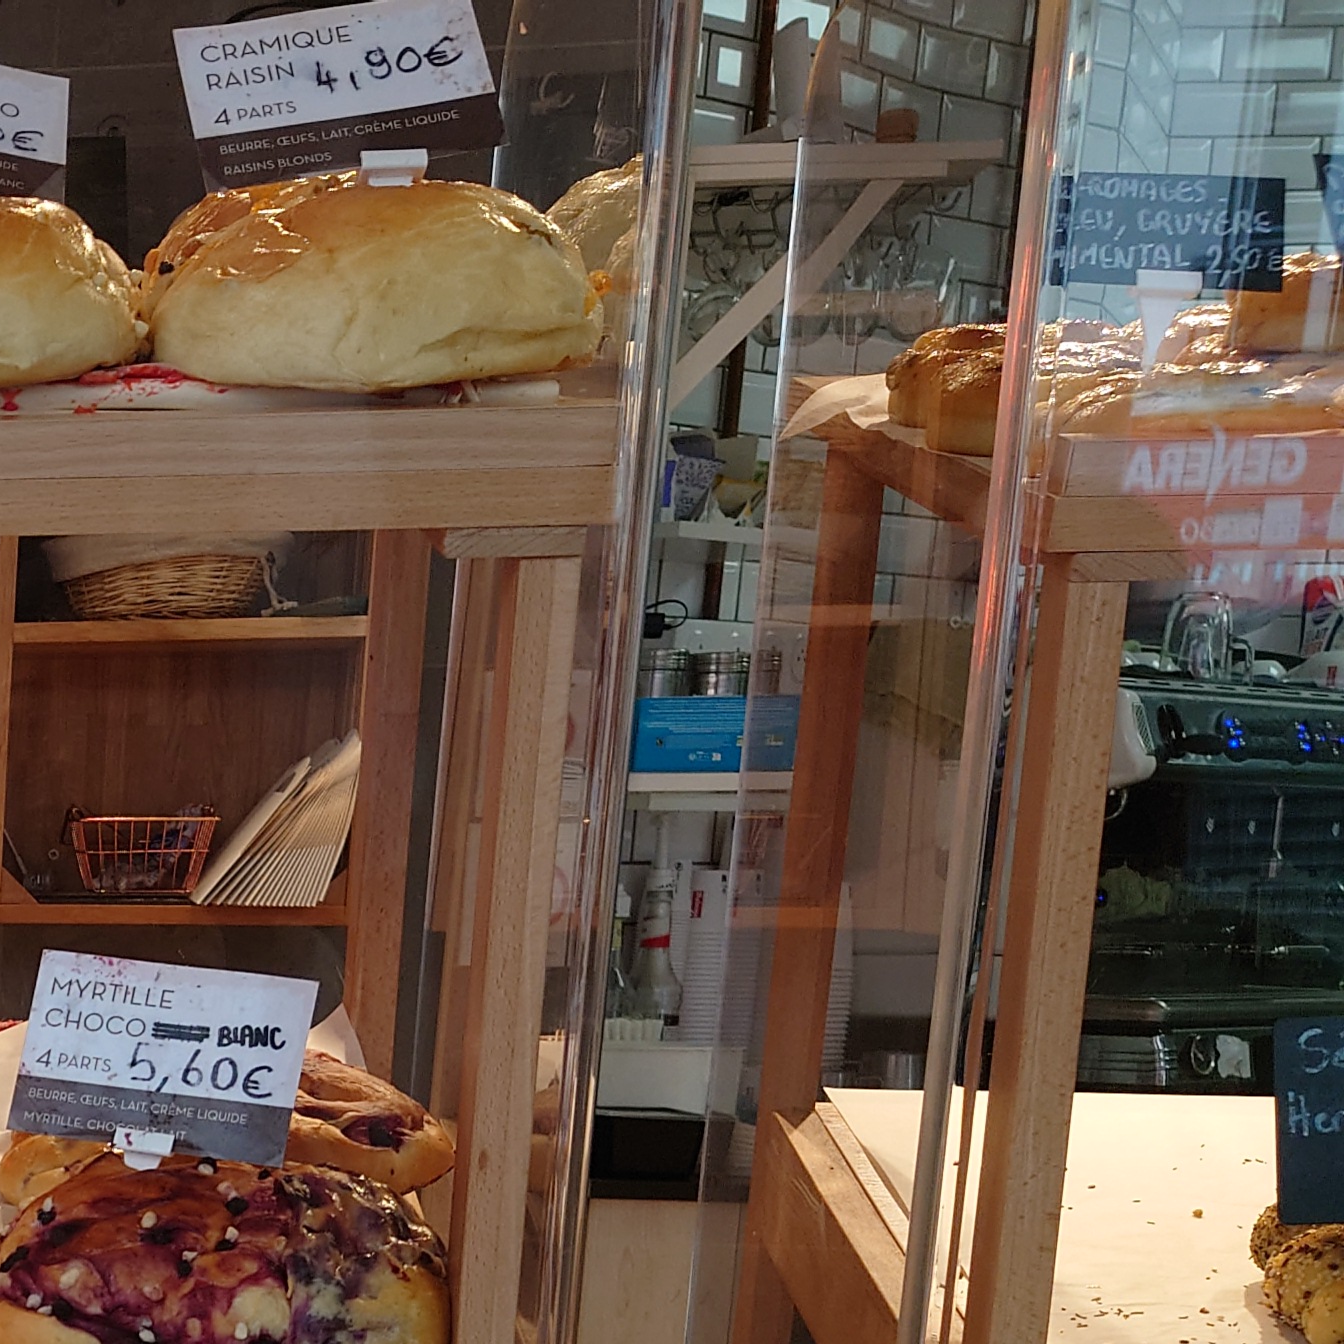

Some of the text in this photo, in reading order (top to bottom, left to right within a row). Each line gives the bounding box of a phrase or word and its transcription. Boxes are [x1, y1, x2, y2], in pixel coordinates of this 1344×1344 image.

[200, 25, 353, 63] CRAMIQUE
[206, 36, 463, 93] RAISIN 4,90€
[214, 101, 297, 125] 4 PARTS
[223, 152, 332, 177] RAISINS BLONDS
[1076, 176, 1208, 203] ROMAGES
[50, 977, 175, 1009] MYRTILLE
[44, 1007, 287, 1050] CHOCO BLANC
[35, 1042, 273, 1099] 4 PARTS 5,60€
